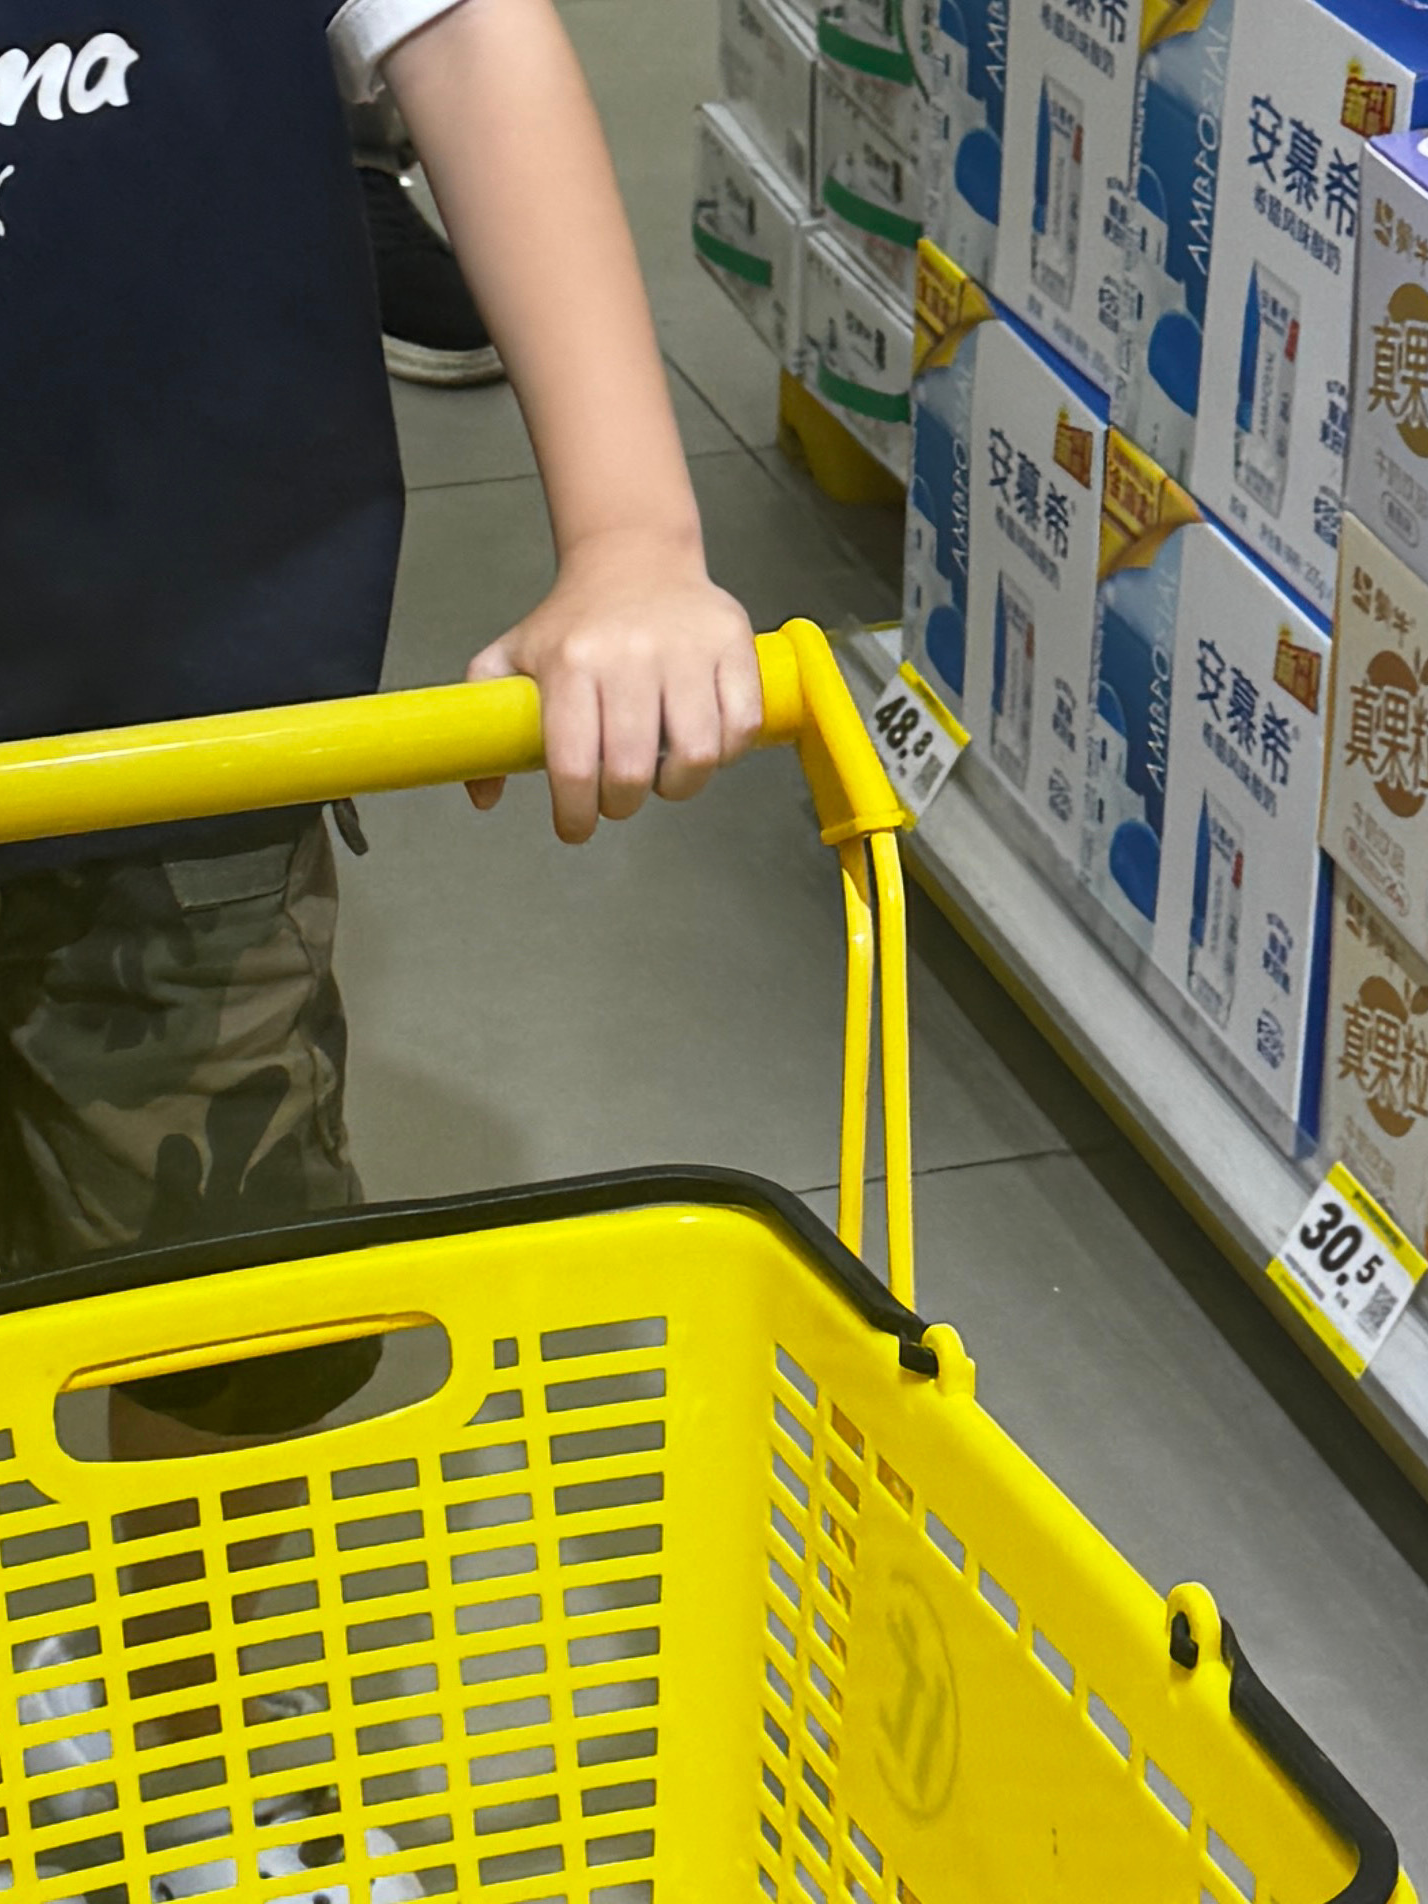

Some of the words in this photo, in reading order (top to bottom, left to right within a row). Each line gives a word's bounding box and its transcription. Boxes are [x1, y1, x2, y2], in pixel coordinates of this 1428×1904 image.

[1248, 95, 1361, 238] 安慕希
[875, 696, 933, 759] 48.8
[1197, 637, 1296, 787] 安慕希
[1300, 1201, 1383, 1287] 30.5
